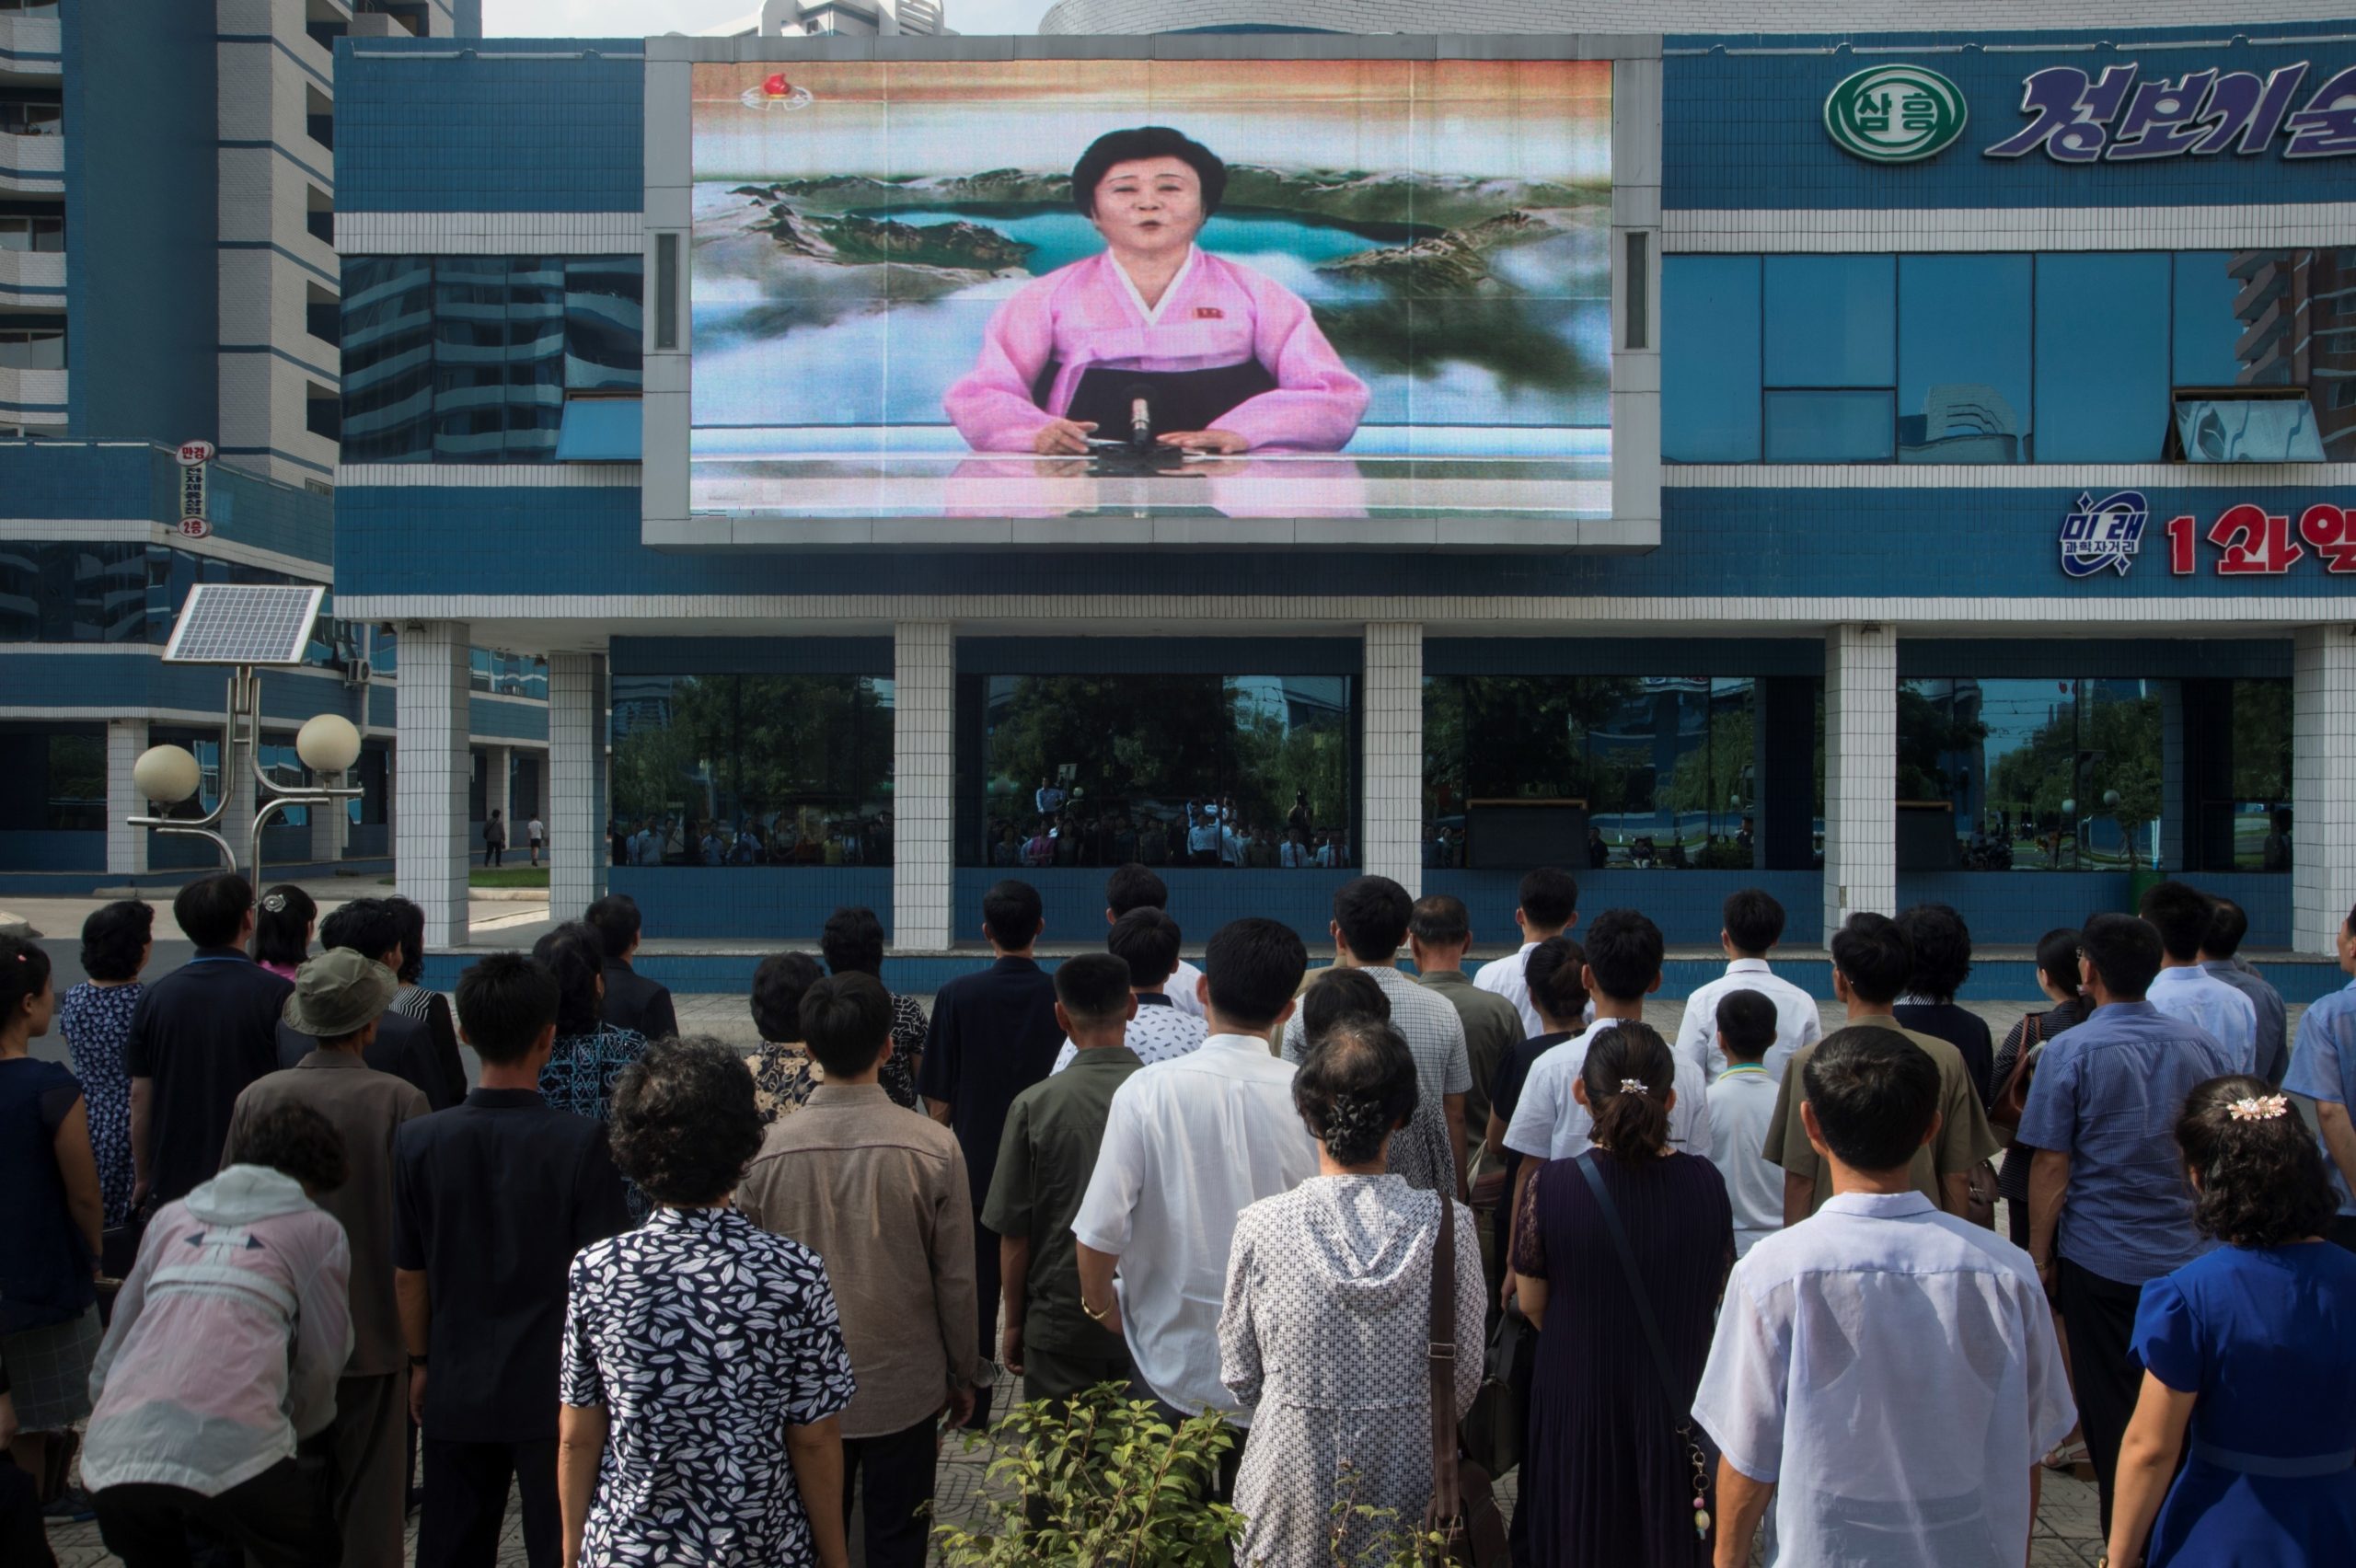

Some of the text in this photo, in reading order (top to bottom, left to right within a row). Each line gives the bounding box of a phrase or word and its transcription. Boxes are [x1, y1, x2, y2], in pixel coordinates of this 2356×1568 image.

[1857, 92, 1935, 132] 삼흥
[182, 446, 205, 460] 만경
[183, 520, 202, 534] 2층
[2062, 513, 2147, 541] 미래
[2064, 541, 2135, 553] 과학자거리
